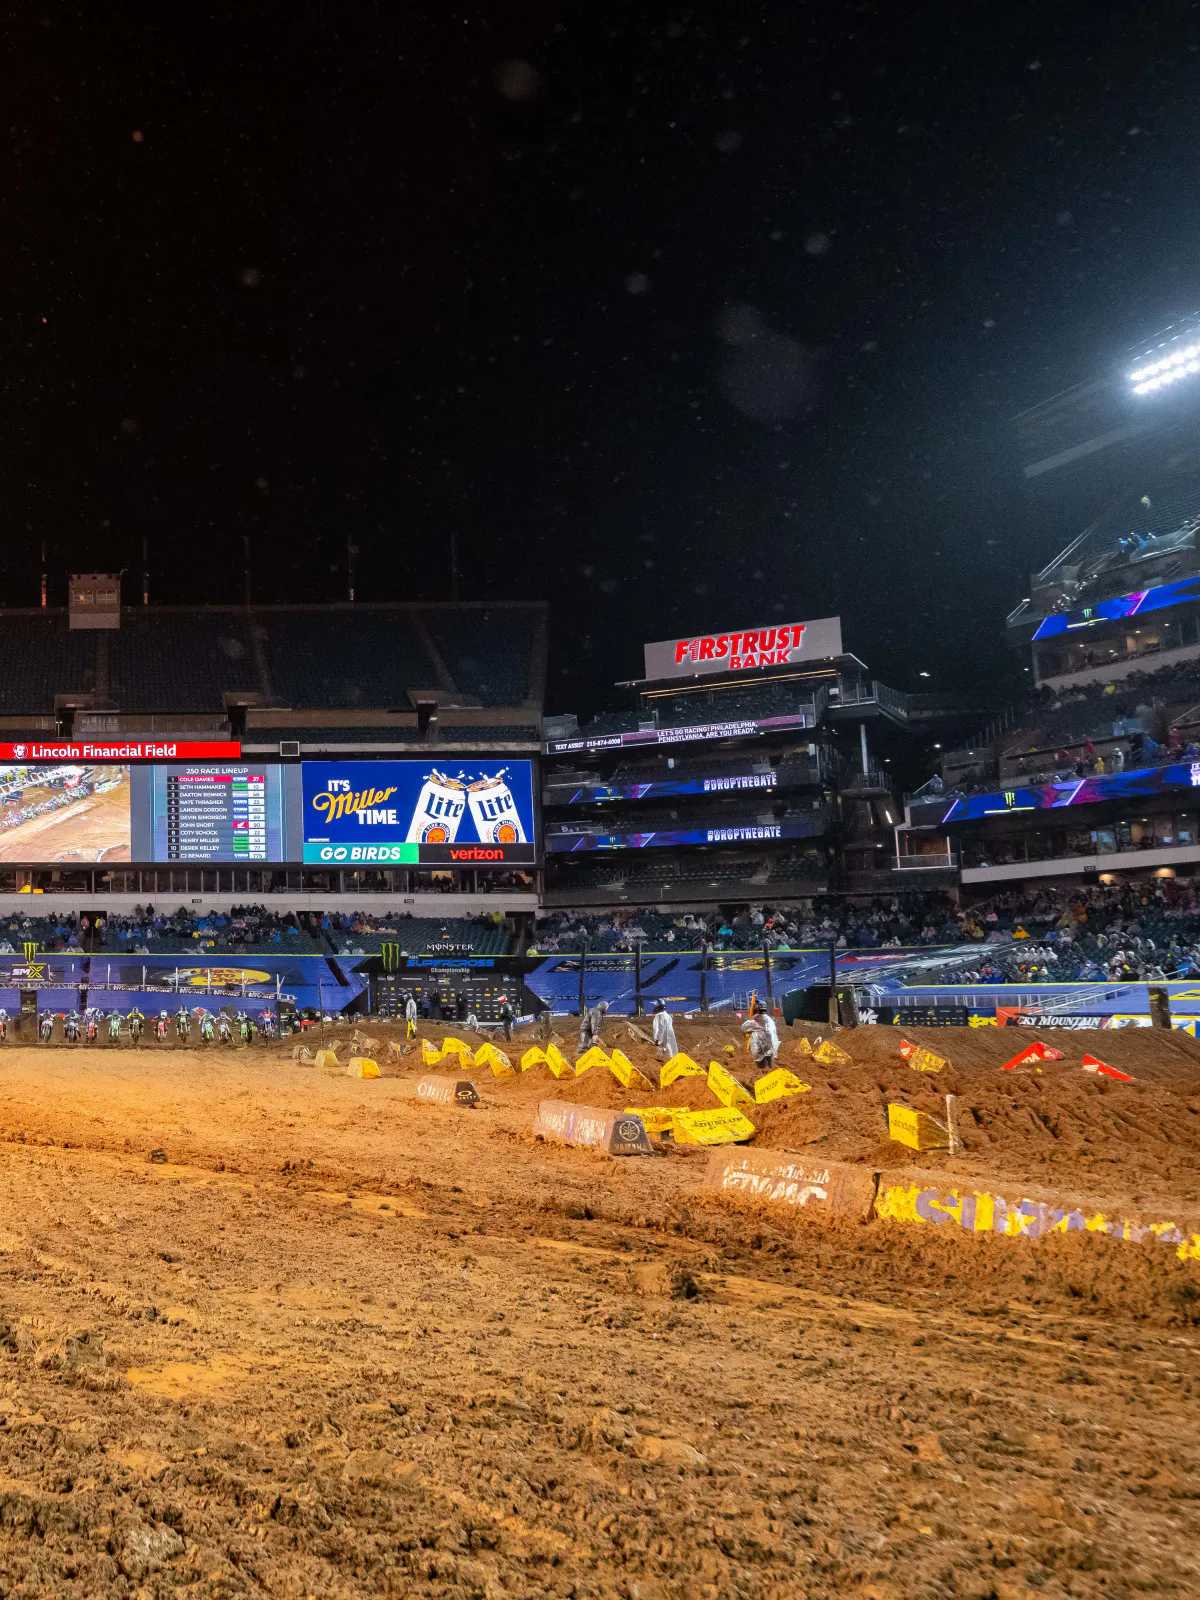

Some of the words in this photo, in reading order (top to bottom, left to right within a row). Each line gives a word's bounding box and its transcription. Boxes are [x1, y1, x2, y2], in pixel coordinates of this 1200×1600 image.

[729, 650, 793, 669] BANK
[31, 744, 80, 758] Lincoln
[82, 744, 143, 757] Financial
[145, 744, 177, 756] Field
[328, 780, 350, 791] IT'S
[703, 774, 777, 791] #DROPTHEGATE
[312, 786, 398, 824] Miller
[425, 791, 463, 820] Lite
[476, 793, 512, 821] Lite
[707, 826, 781, 841] #DROPTHEGATE
[350, 847, 401, 860] BIRDS
[450, 847, 504, 860] verizon
[427, 942, 475, 951] MONSTER
[11, 965, 45, 979] SMX
[1039, 1015, 1101, 1027] MOUNTAIN
